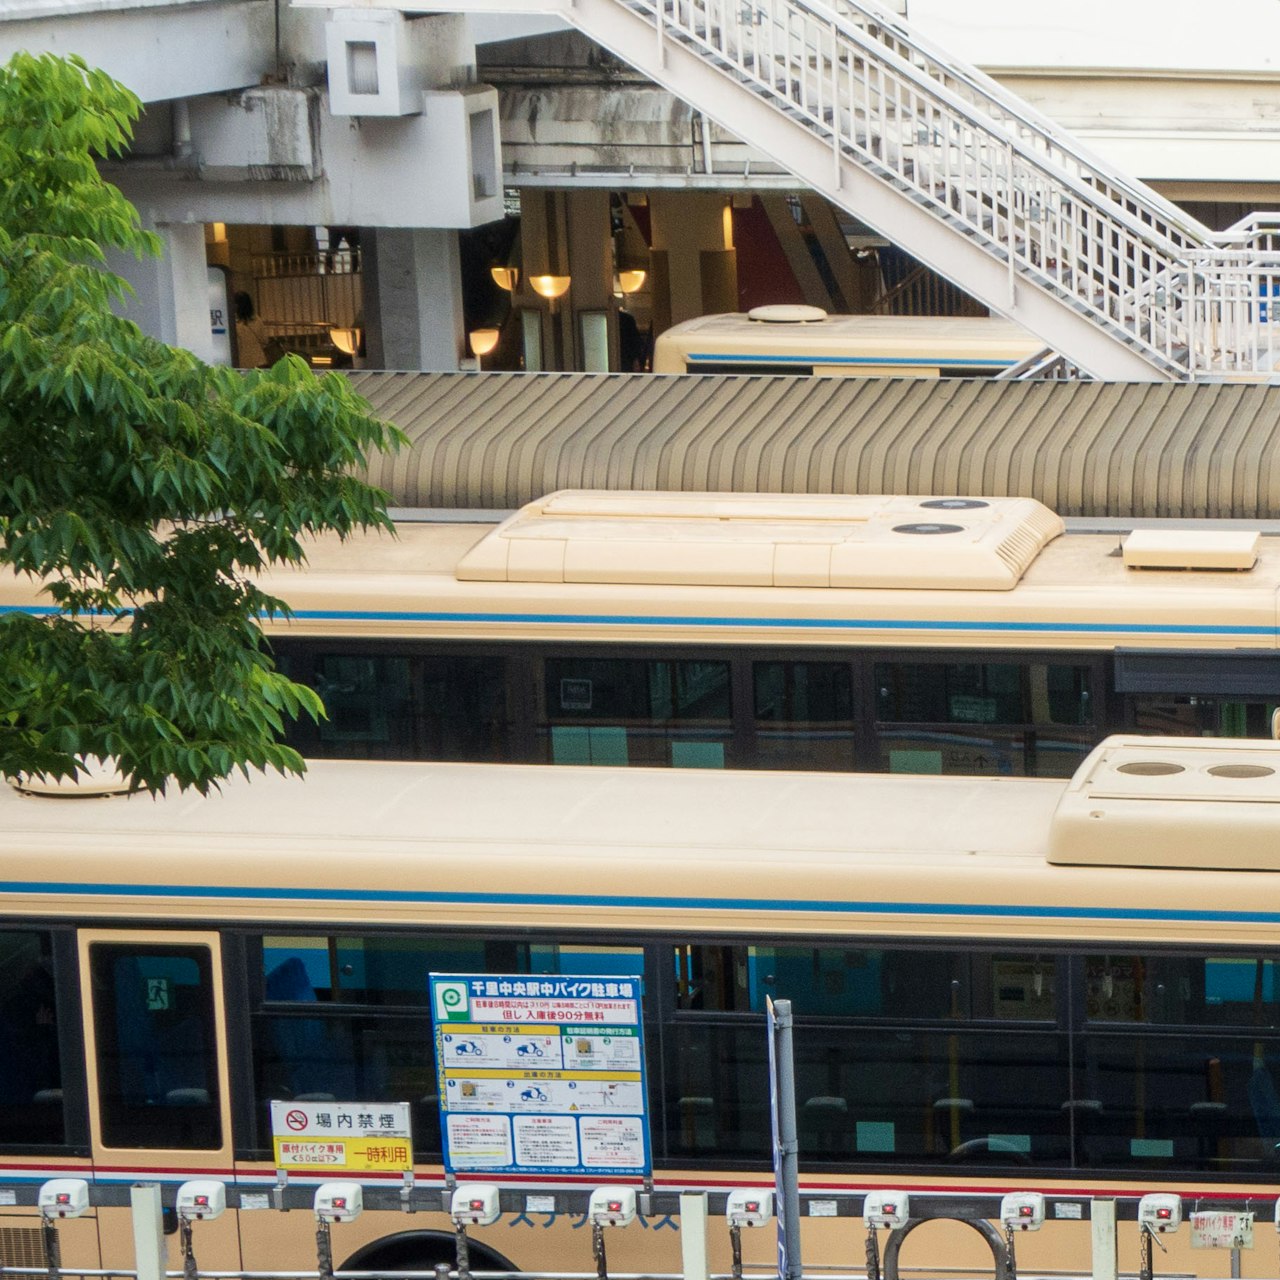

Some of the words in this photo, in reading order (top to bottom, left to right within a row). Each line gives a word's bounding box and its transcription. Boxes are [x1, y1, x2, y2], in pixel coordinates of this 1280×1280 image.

[502, 1011, 522, 1020] 但し
[315, 1113, 395, 1129] 場内禁煙
[282, 1144, 344, 1154] 原付バイク専用
[354, 1146, 407, 1163] 一時利用
